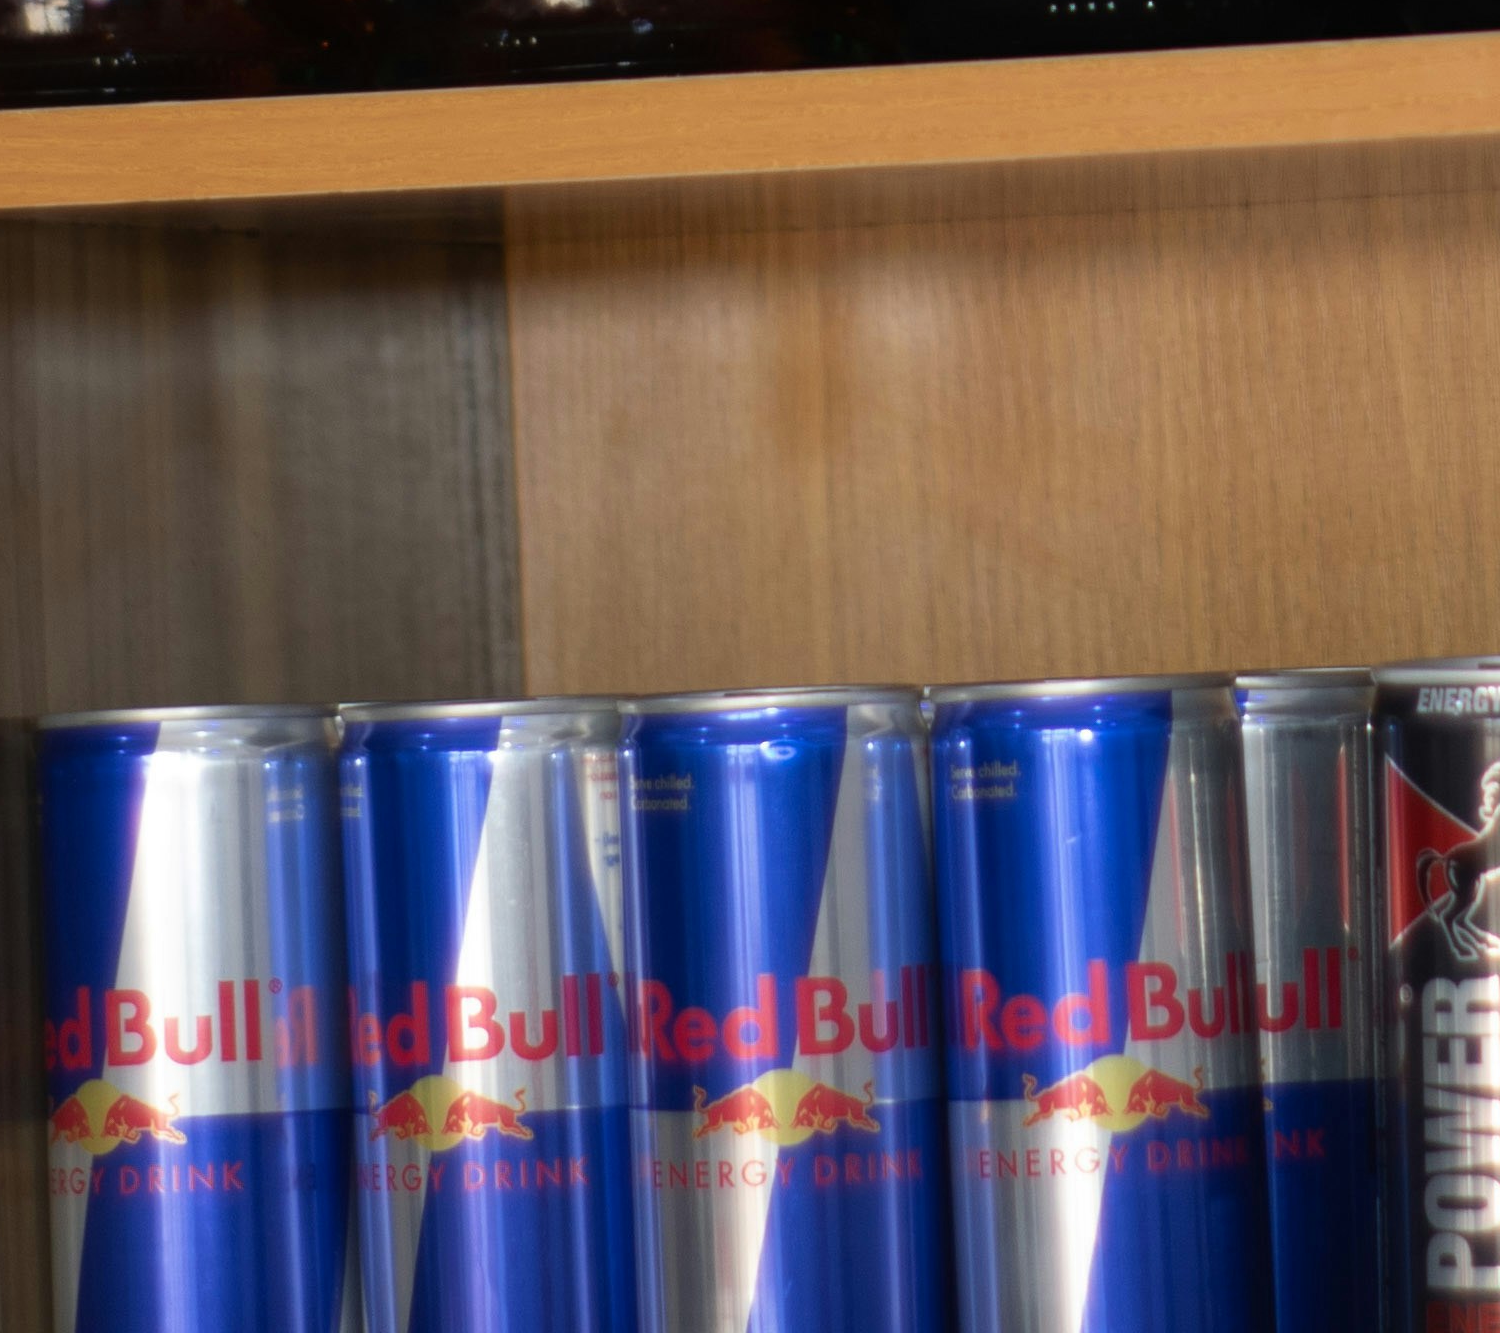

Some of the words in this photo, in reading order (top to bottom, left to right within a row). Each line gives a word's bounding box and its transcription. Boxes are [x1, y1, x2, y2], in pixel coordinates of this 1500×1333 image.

[45, 986, 93, 1069] ed
[105, 978, 262, 1067] Bull
[444, 972, 604, 1063] Bull
[638, 973, 780, 1064] Red
[794, 964, 930, 1057] Bull
